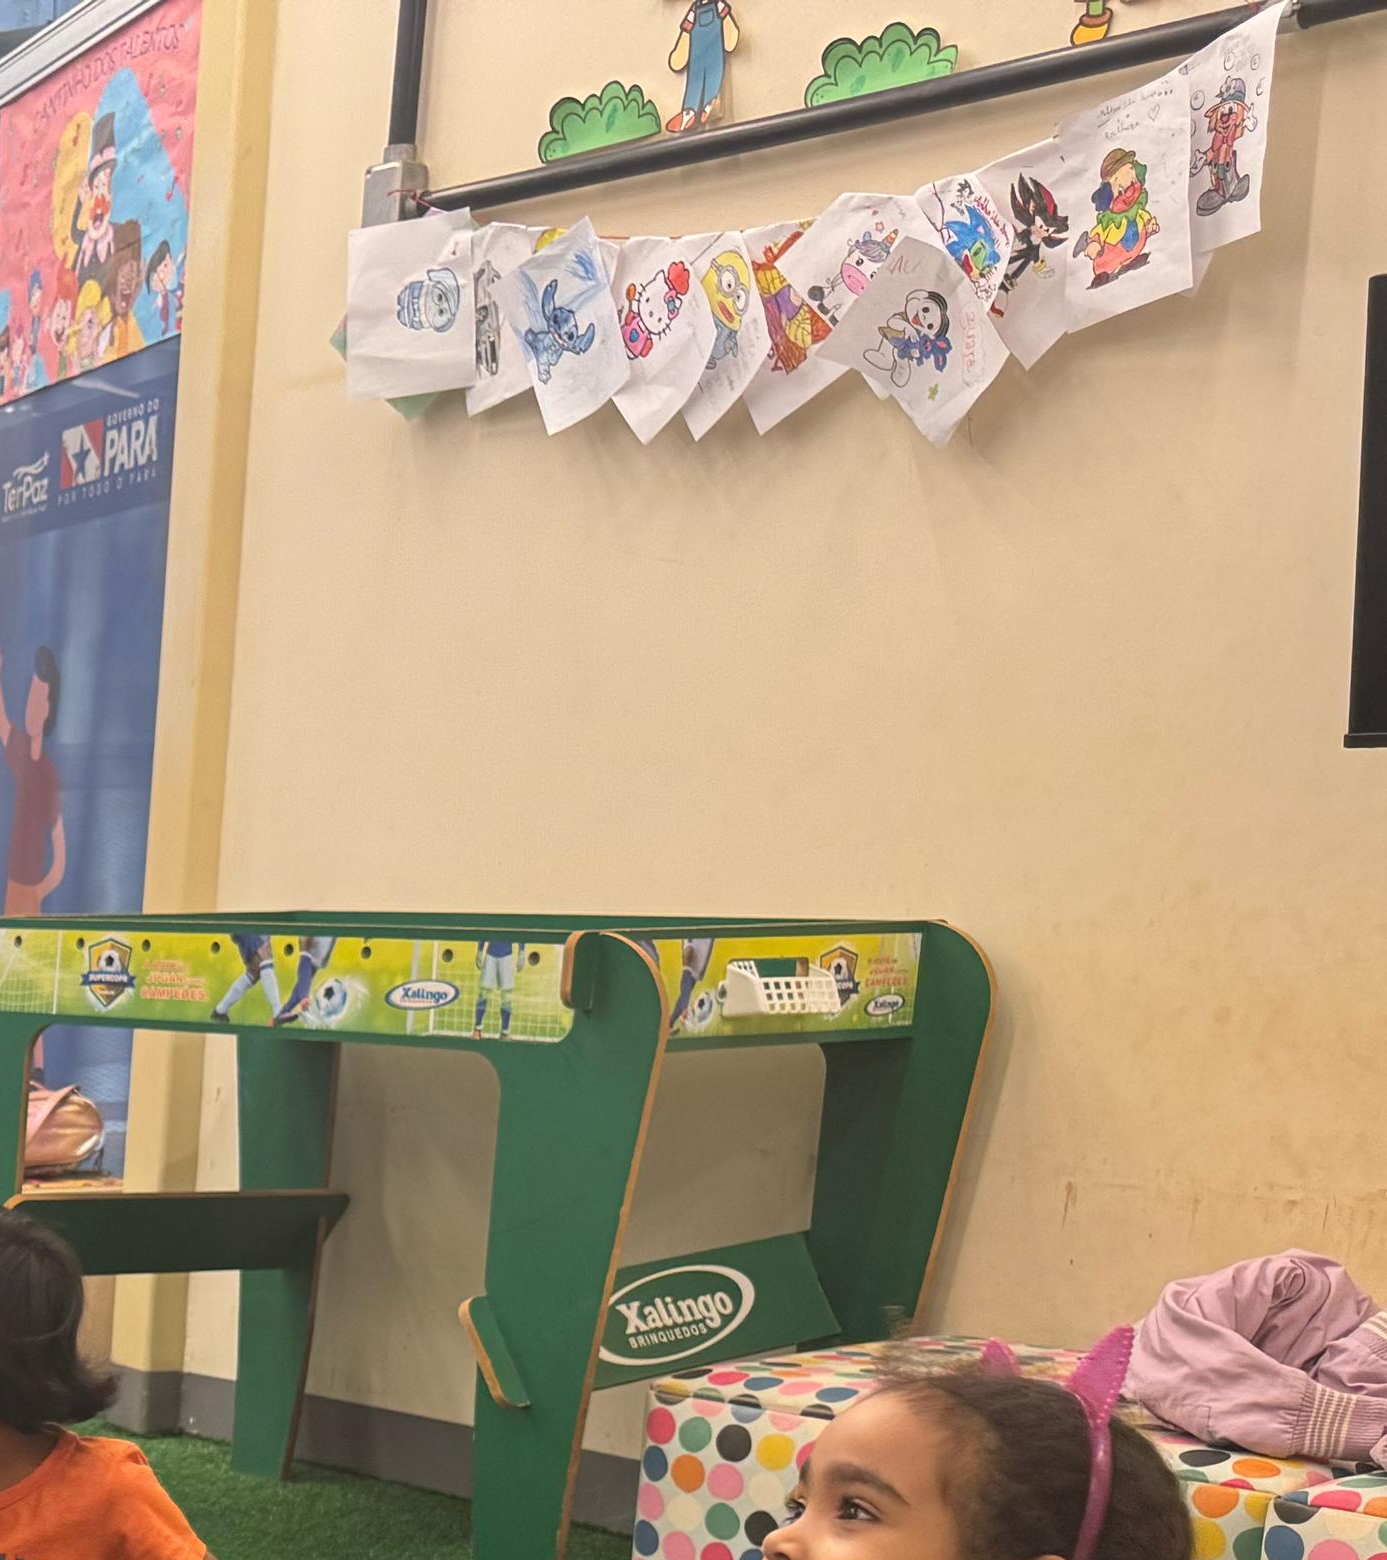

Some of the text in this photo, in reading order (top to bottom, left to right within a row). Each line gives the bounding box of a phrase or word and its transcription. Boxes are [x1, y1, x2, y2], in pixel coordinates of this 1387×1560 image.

[106, 398, 160, 427] GOVERNO DO
[2, 475, 49, 513] TerPaz
[57, 492, 77, 505] POR
[82, 481, 109, 498] TODO
[116, 477, 123, 490] O
[401, 986, 448, 1004] Xalingo
[615, 1291, 735, 1335] Xalingo
[628, 1323, 708, 1350] BRINQUEDOS
